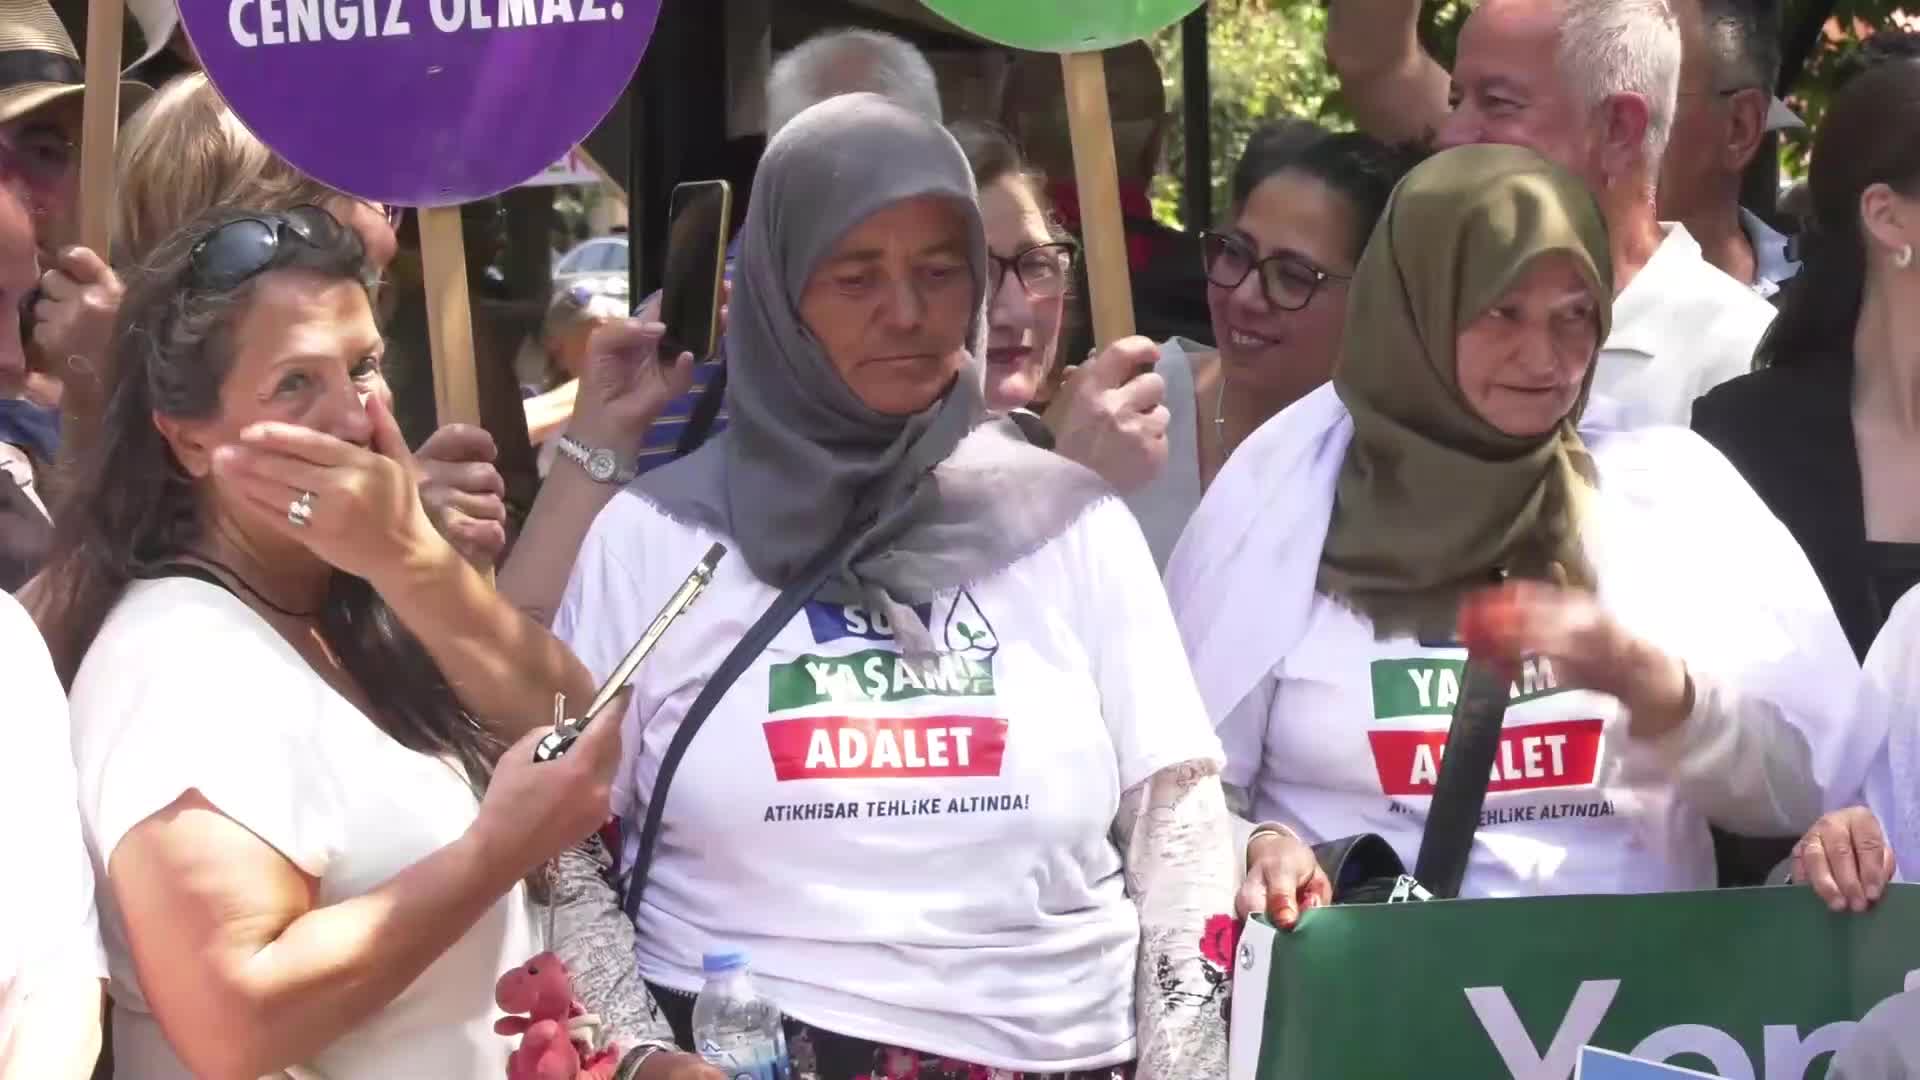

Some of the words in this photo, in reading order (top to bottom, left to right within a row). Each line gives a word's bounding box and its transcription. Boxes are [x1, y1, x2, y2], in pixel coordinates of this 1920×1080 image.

[1408, 655, 1557, 707] YAM
[805, 727, 972, 769] ADALET
[1409, 734, 1567, 785] ALET
[947, 794, 1030, 813] ALTINDA!
